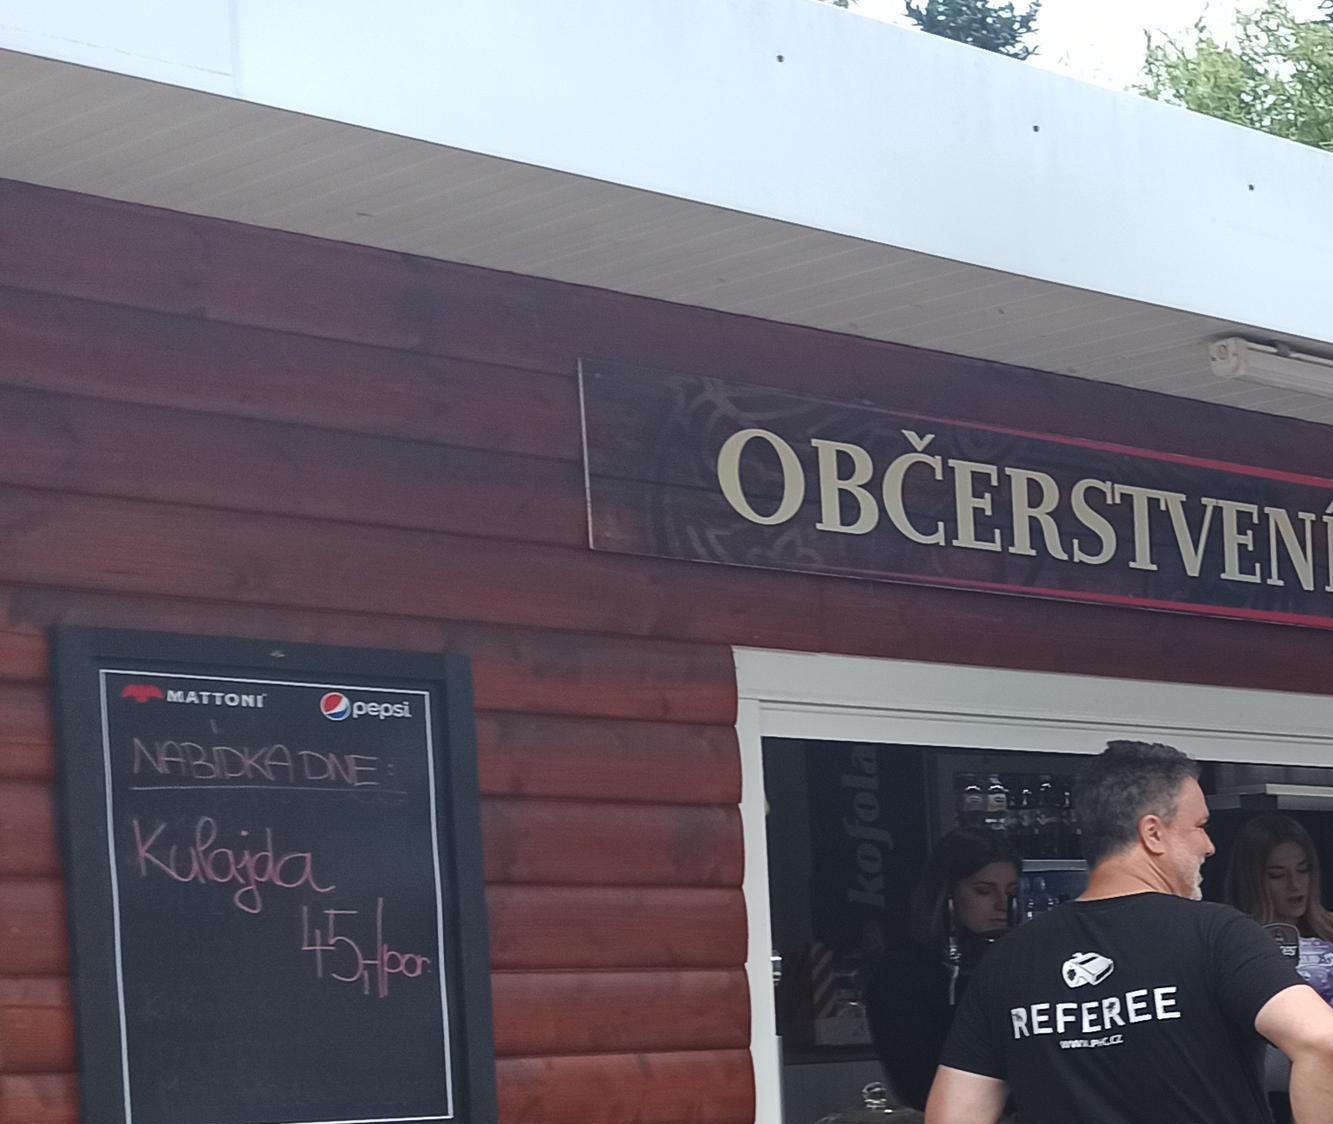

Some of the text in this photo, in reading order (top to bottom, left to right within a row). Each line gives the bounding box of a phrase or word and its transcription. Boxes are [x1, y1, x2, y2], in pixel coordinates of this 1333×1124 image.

[166, 689, 264, 709] MATTONI
[352, 699, 412, 719] pepsi
[133, 719, 295, 782] NABÍDKA
[132, 817, 336, 913] Kulajda
[1010, 986, 1181, 1039] REFEREE
